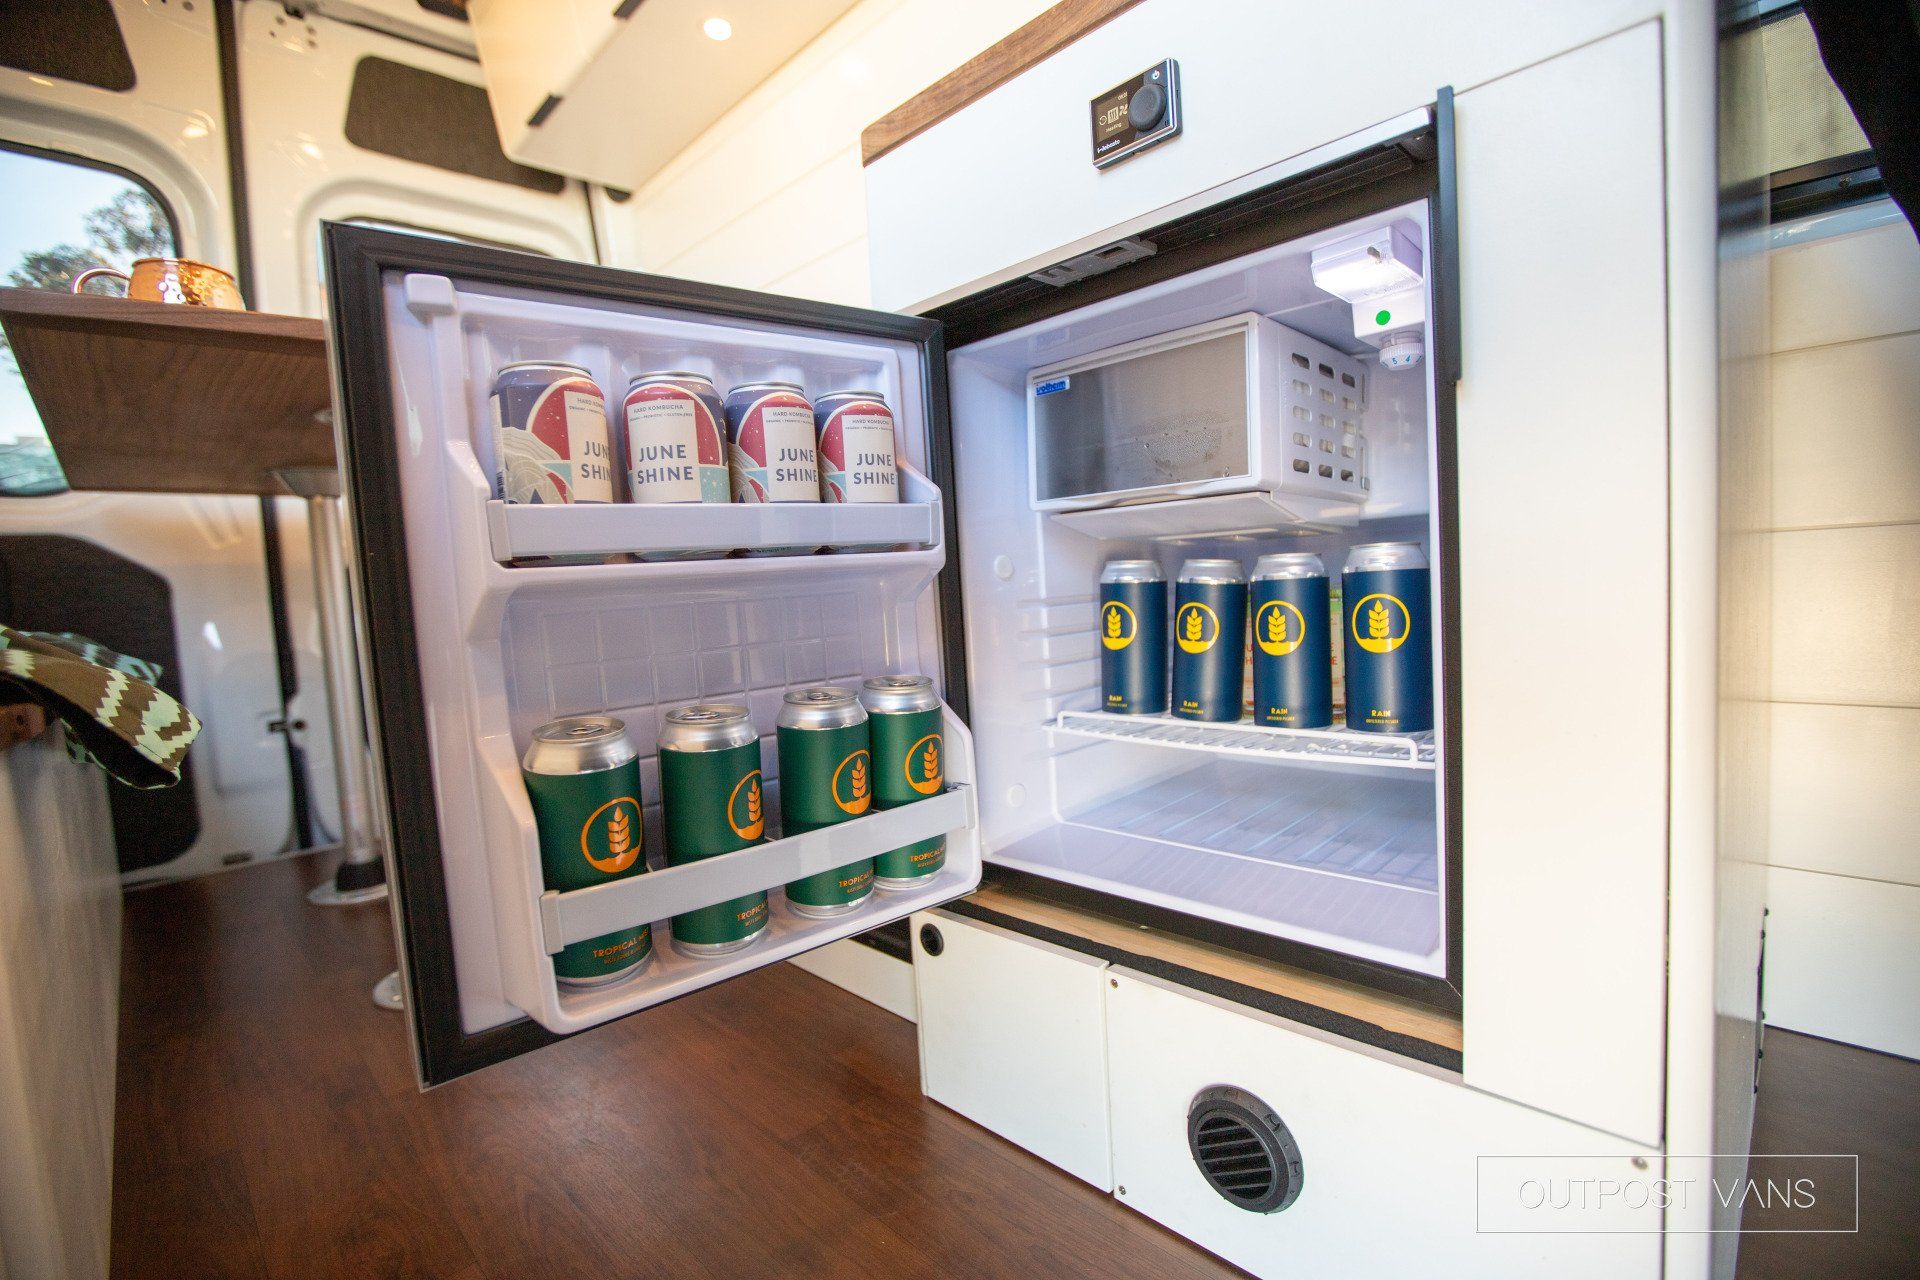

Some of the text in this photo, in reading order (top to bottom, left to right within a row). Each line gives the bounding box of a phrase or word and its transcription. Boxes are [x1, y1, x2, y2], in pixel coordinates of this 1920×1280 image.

[1391, 357, 1398, 365] 5
[1405, 355, 1411, 363] 4
[639, 444, 687, 462] JUNE
[779, 448, 814, 462] JUNE
[856, 453, 892, 466] JUNE
[637, 465, 694, 485] SHINE
[776, 468, 817, 483] SHINE
[853, 472, 895, 485] SHINE
[1183, 700, 1198, 708] RAIN
[1270, 707, 1288, 715] RAIN
[1371, 709, 1391, 717] RAIN
[593, 937, 637, 958] TROPICAL
